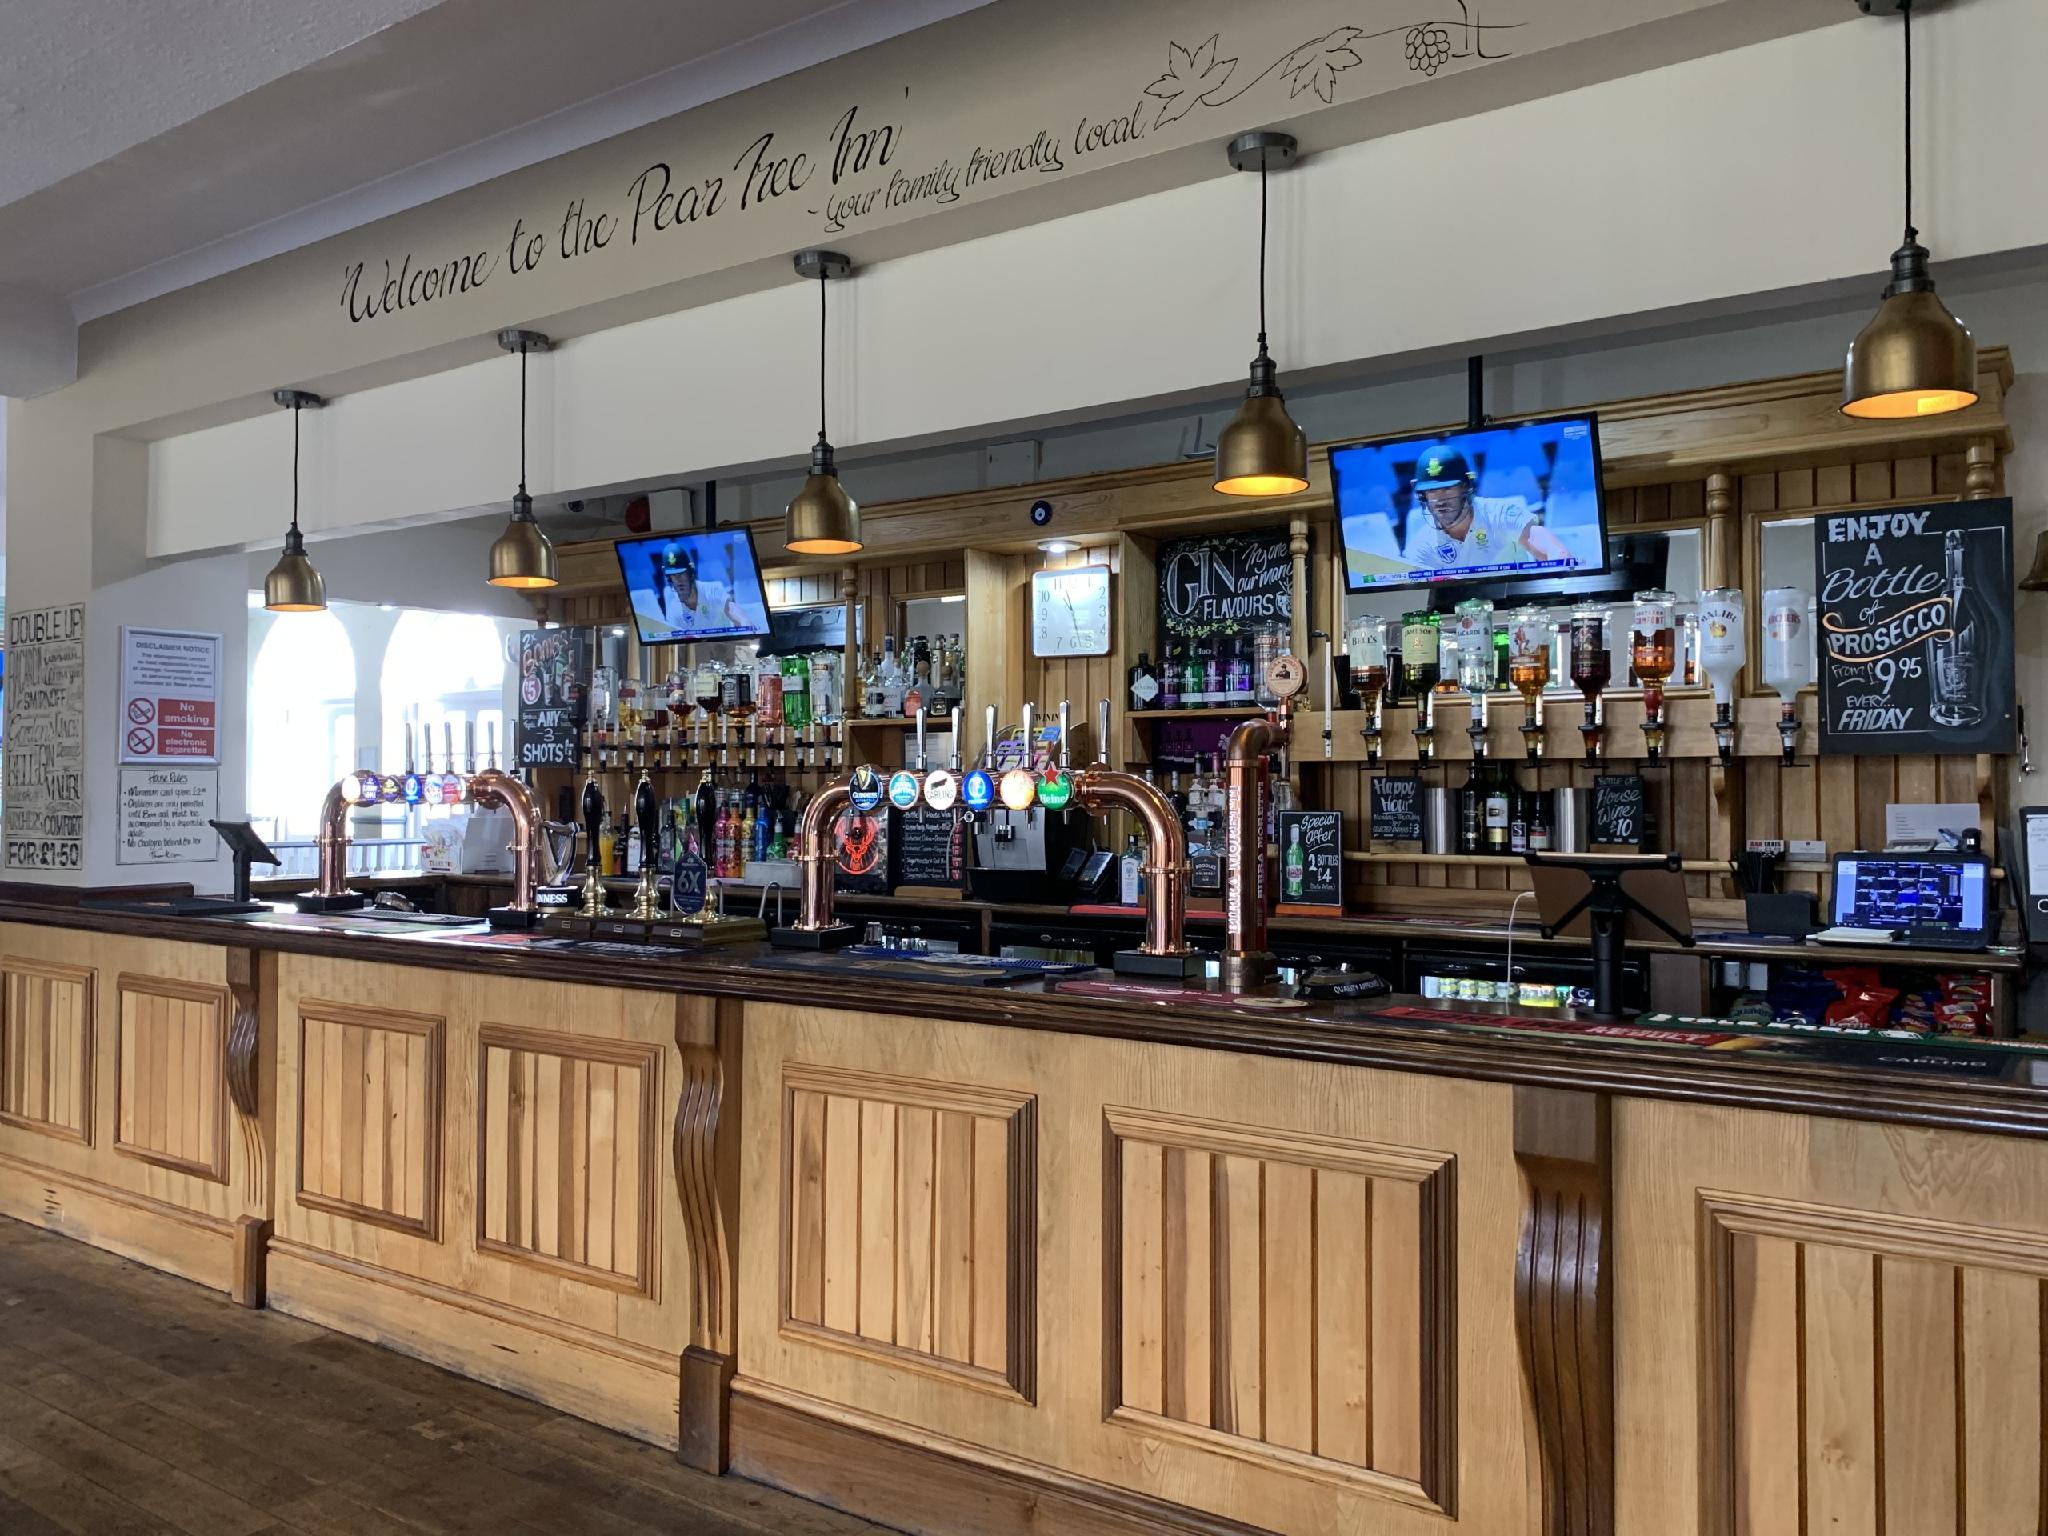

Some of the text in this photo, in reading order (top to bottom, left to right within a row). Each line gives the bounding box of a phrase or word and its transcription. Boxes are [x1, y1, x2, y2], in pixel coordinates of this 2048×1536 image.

[824, 188, 882, 233] your
[885, 159, 961, 209] family
[965, 130, 1064, 188] friendly
[507, 218, 548, 275] to
[558, 200, 620, 260] the
[627, 162, 728, 246] Pear
[734, 132, 816, 211] Tree
[1828, 511, 1932, 542] ENJOY
[1864, 542, 1883, 567] A
[1167, 542, 1288, 616] GIN Try one
[1237, 574, 1259, 594] our
[1822, 564, 1946, 602] Bottle
[1203, 593, 1275, 621] FLAVOURS
[1859, 599, 1885, 625] of
[11, 608, 81, 645] DOUBLE UP
[1829, 604, 1946, 655] PROSECCO
[183, 645, 210, 653] NOTICE
[1831, 664, 1866, 679] From
[180, 702, 194, 711] No
[164, 715, 209, 725] smoking
[538, 711, 562, 727] ANY
[1838, 707, 1914, 731] FRIDAY
[165, 738, 207, 746] electronic
[181, 730, 193, 738] No
[544, 728, 555, 742] 3
[165, 746, 207, 754] cigarettes
[523, 743, 564, 763] SHOTS
[149, 772, 188, 783] House Rules
[1374, 778, 1416, 798] Happy
[1381, 795, 1413, 812] Hour
[1597, 788, 1640, 810] House
[1301, 813, 1336, 832] Special
[1598, 805, 1637, 825] Wine
[1306, 828, 1336, 844] Offer
[9, 842, 36, 865] FOR
[677, 870, 701, 893] 6X
[1878, 1056, 1987, 1067] CARLING
